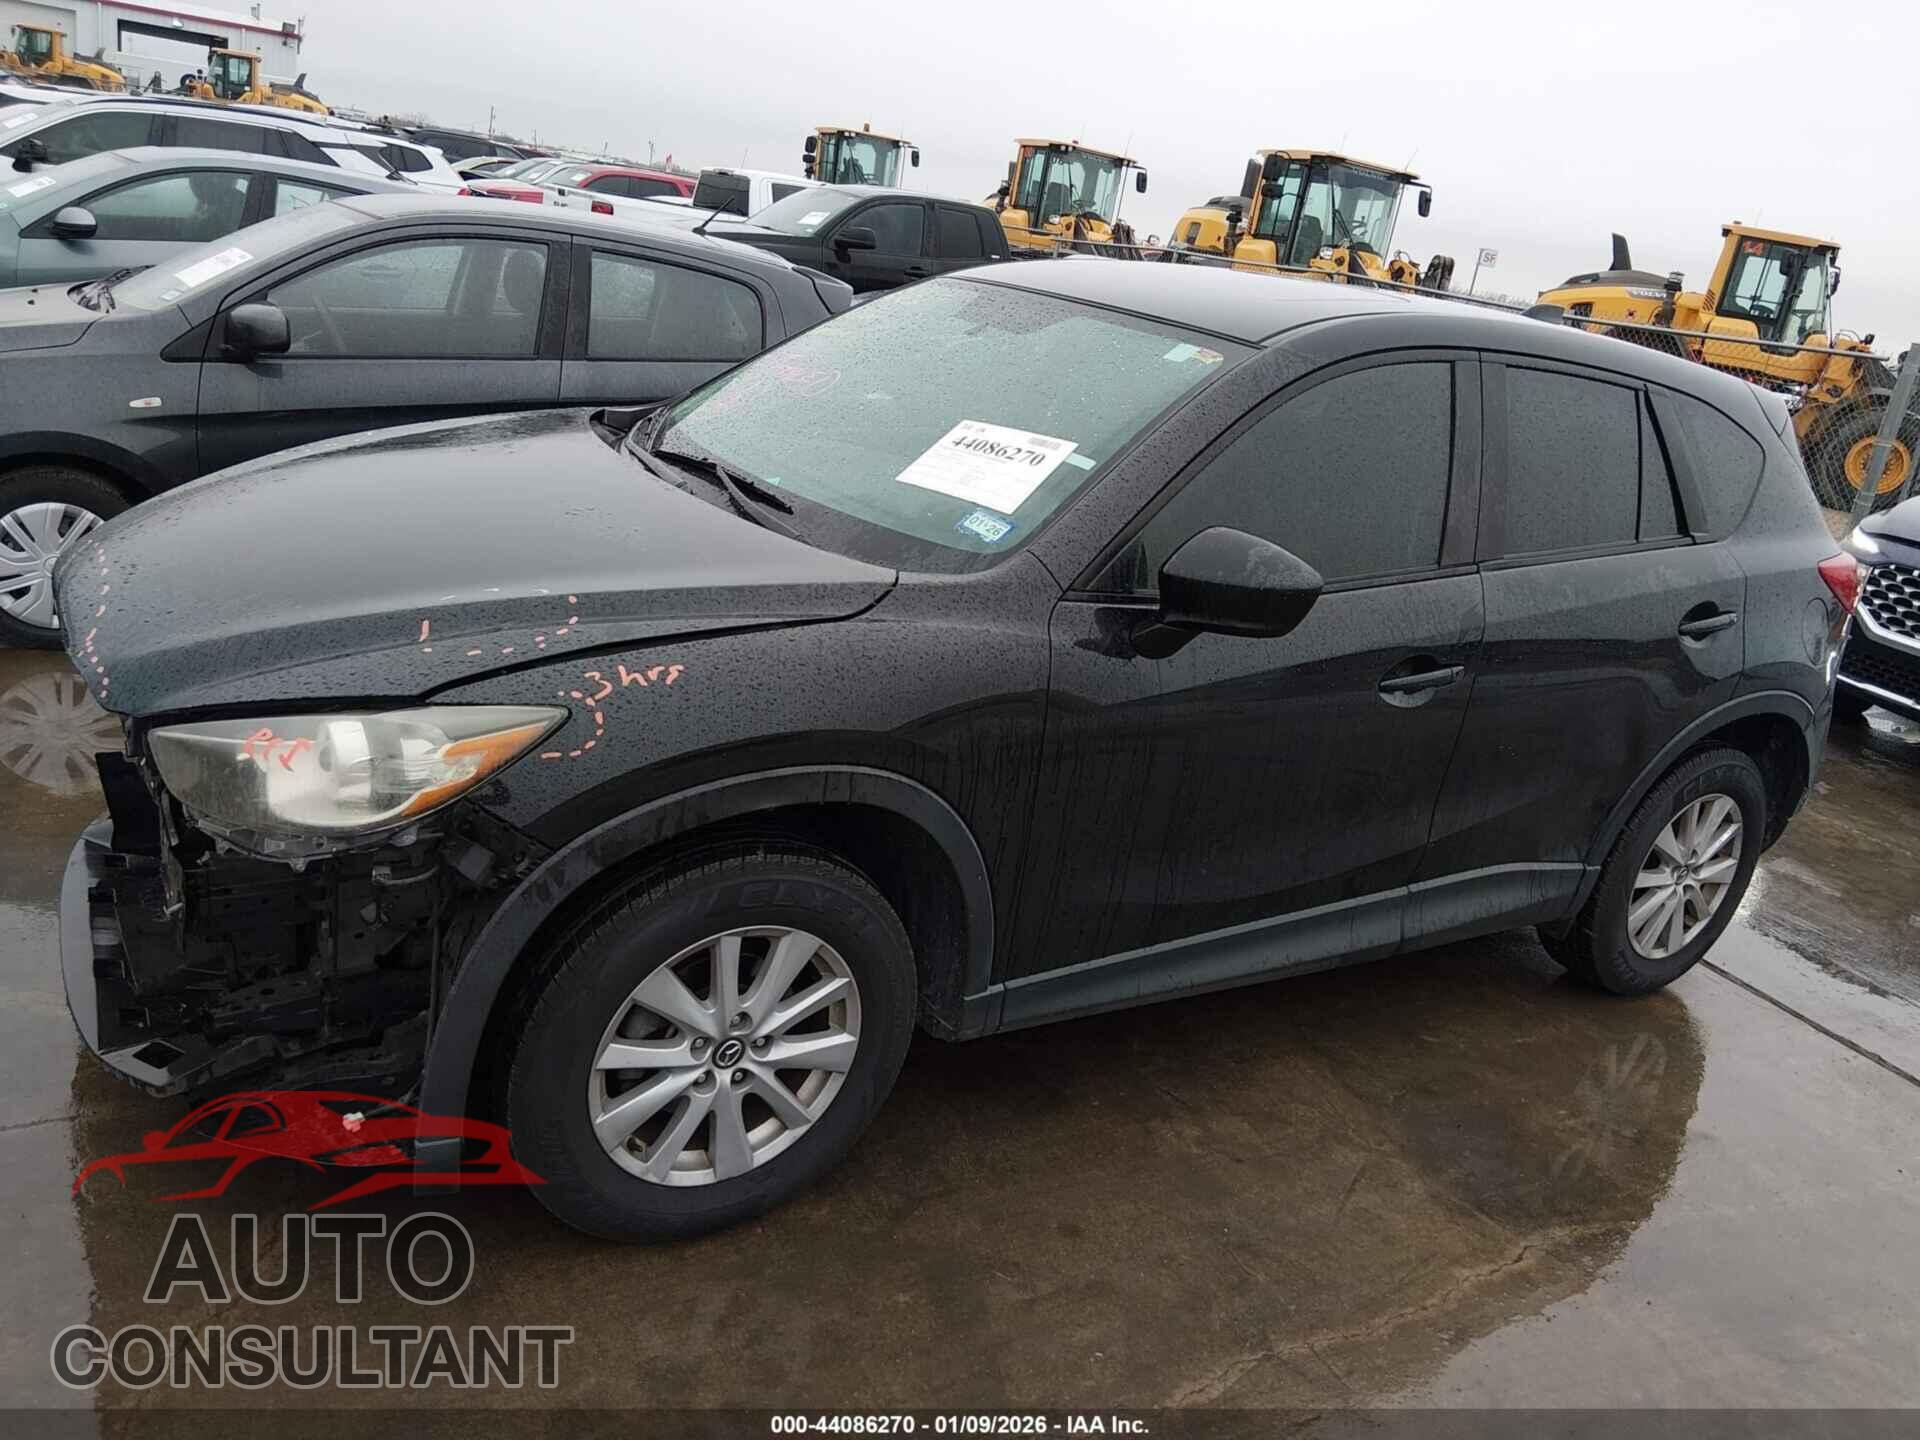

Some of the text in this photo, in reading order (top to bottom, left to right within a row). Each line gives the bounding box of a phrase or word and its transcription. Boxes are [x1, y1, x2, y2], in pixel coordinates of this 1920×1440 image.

[952, 436, 1047, 467] 44086270
[583, 664, 685, 700] 3 hrs
